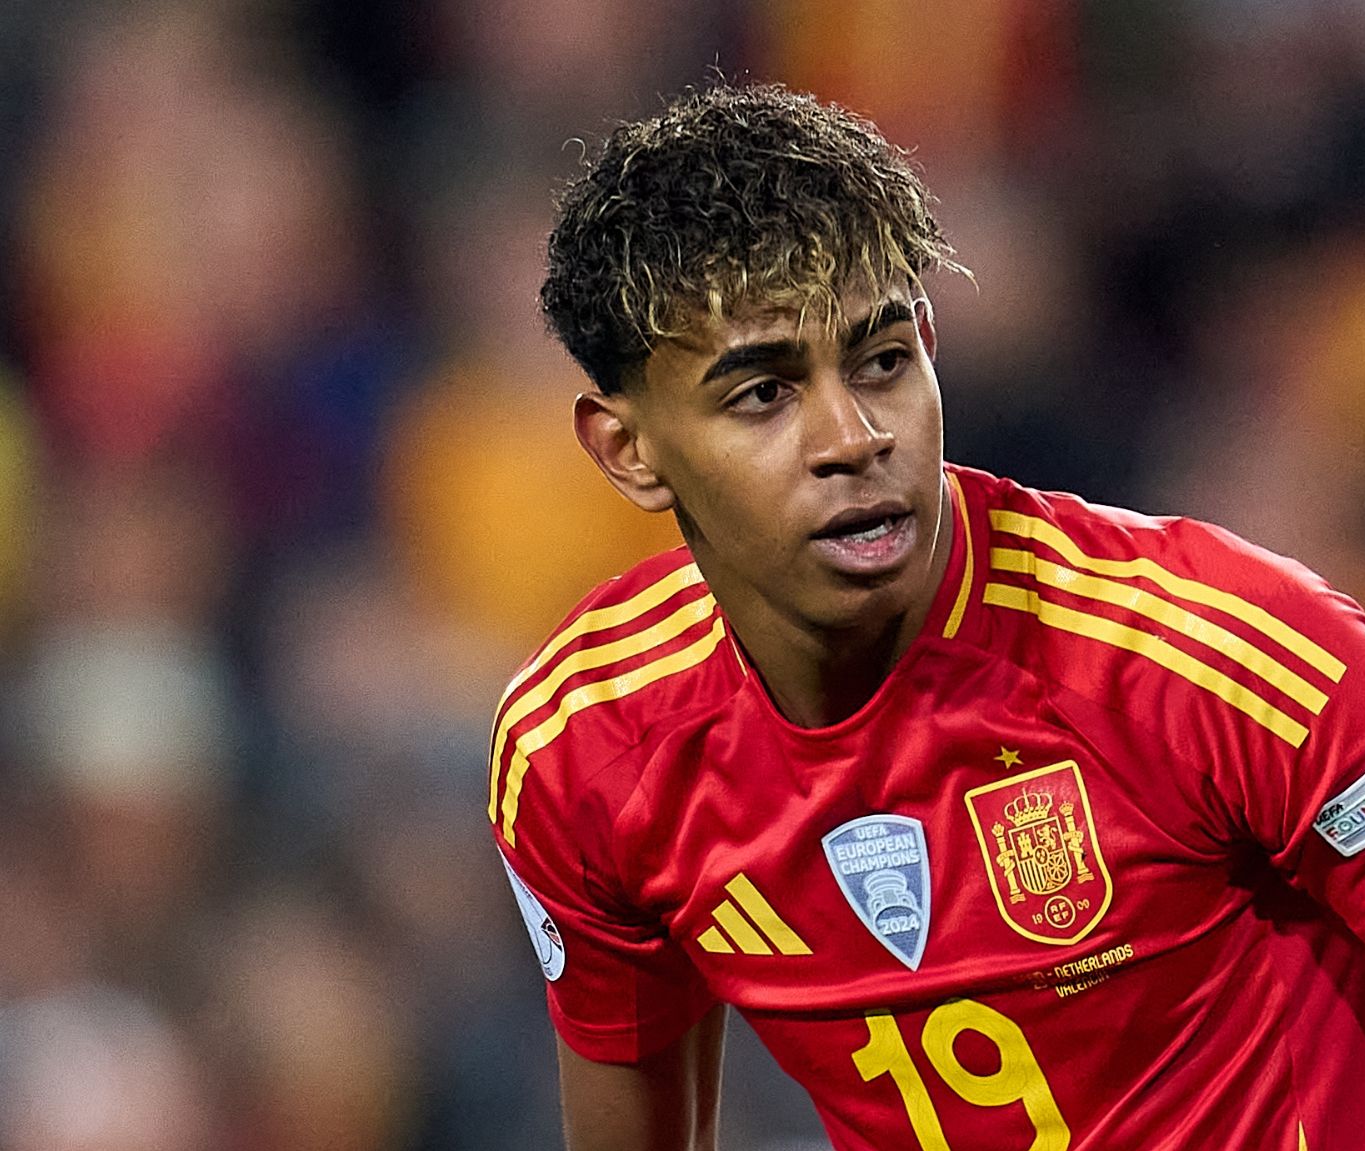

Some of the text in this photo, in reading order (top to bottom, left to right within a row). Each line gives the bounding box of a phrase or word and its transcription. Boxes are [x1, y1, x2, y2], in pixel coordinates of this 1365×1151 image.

[1315, 802, 1344, 826] UEFA
[856, 824, 888, 840] UEFA
[835, 833, 917, 861] EUROPEAN
[840, 850, 922, 875] CHAMPIONS
[880, 914, 920, 935] 2024
[1053, 943, 1134, 979] NETHERLANDS
